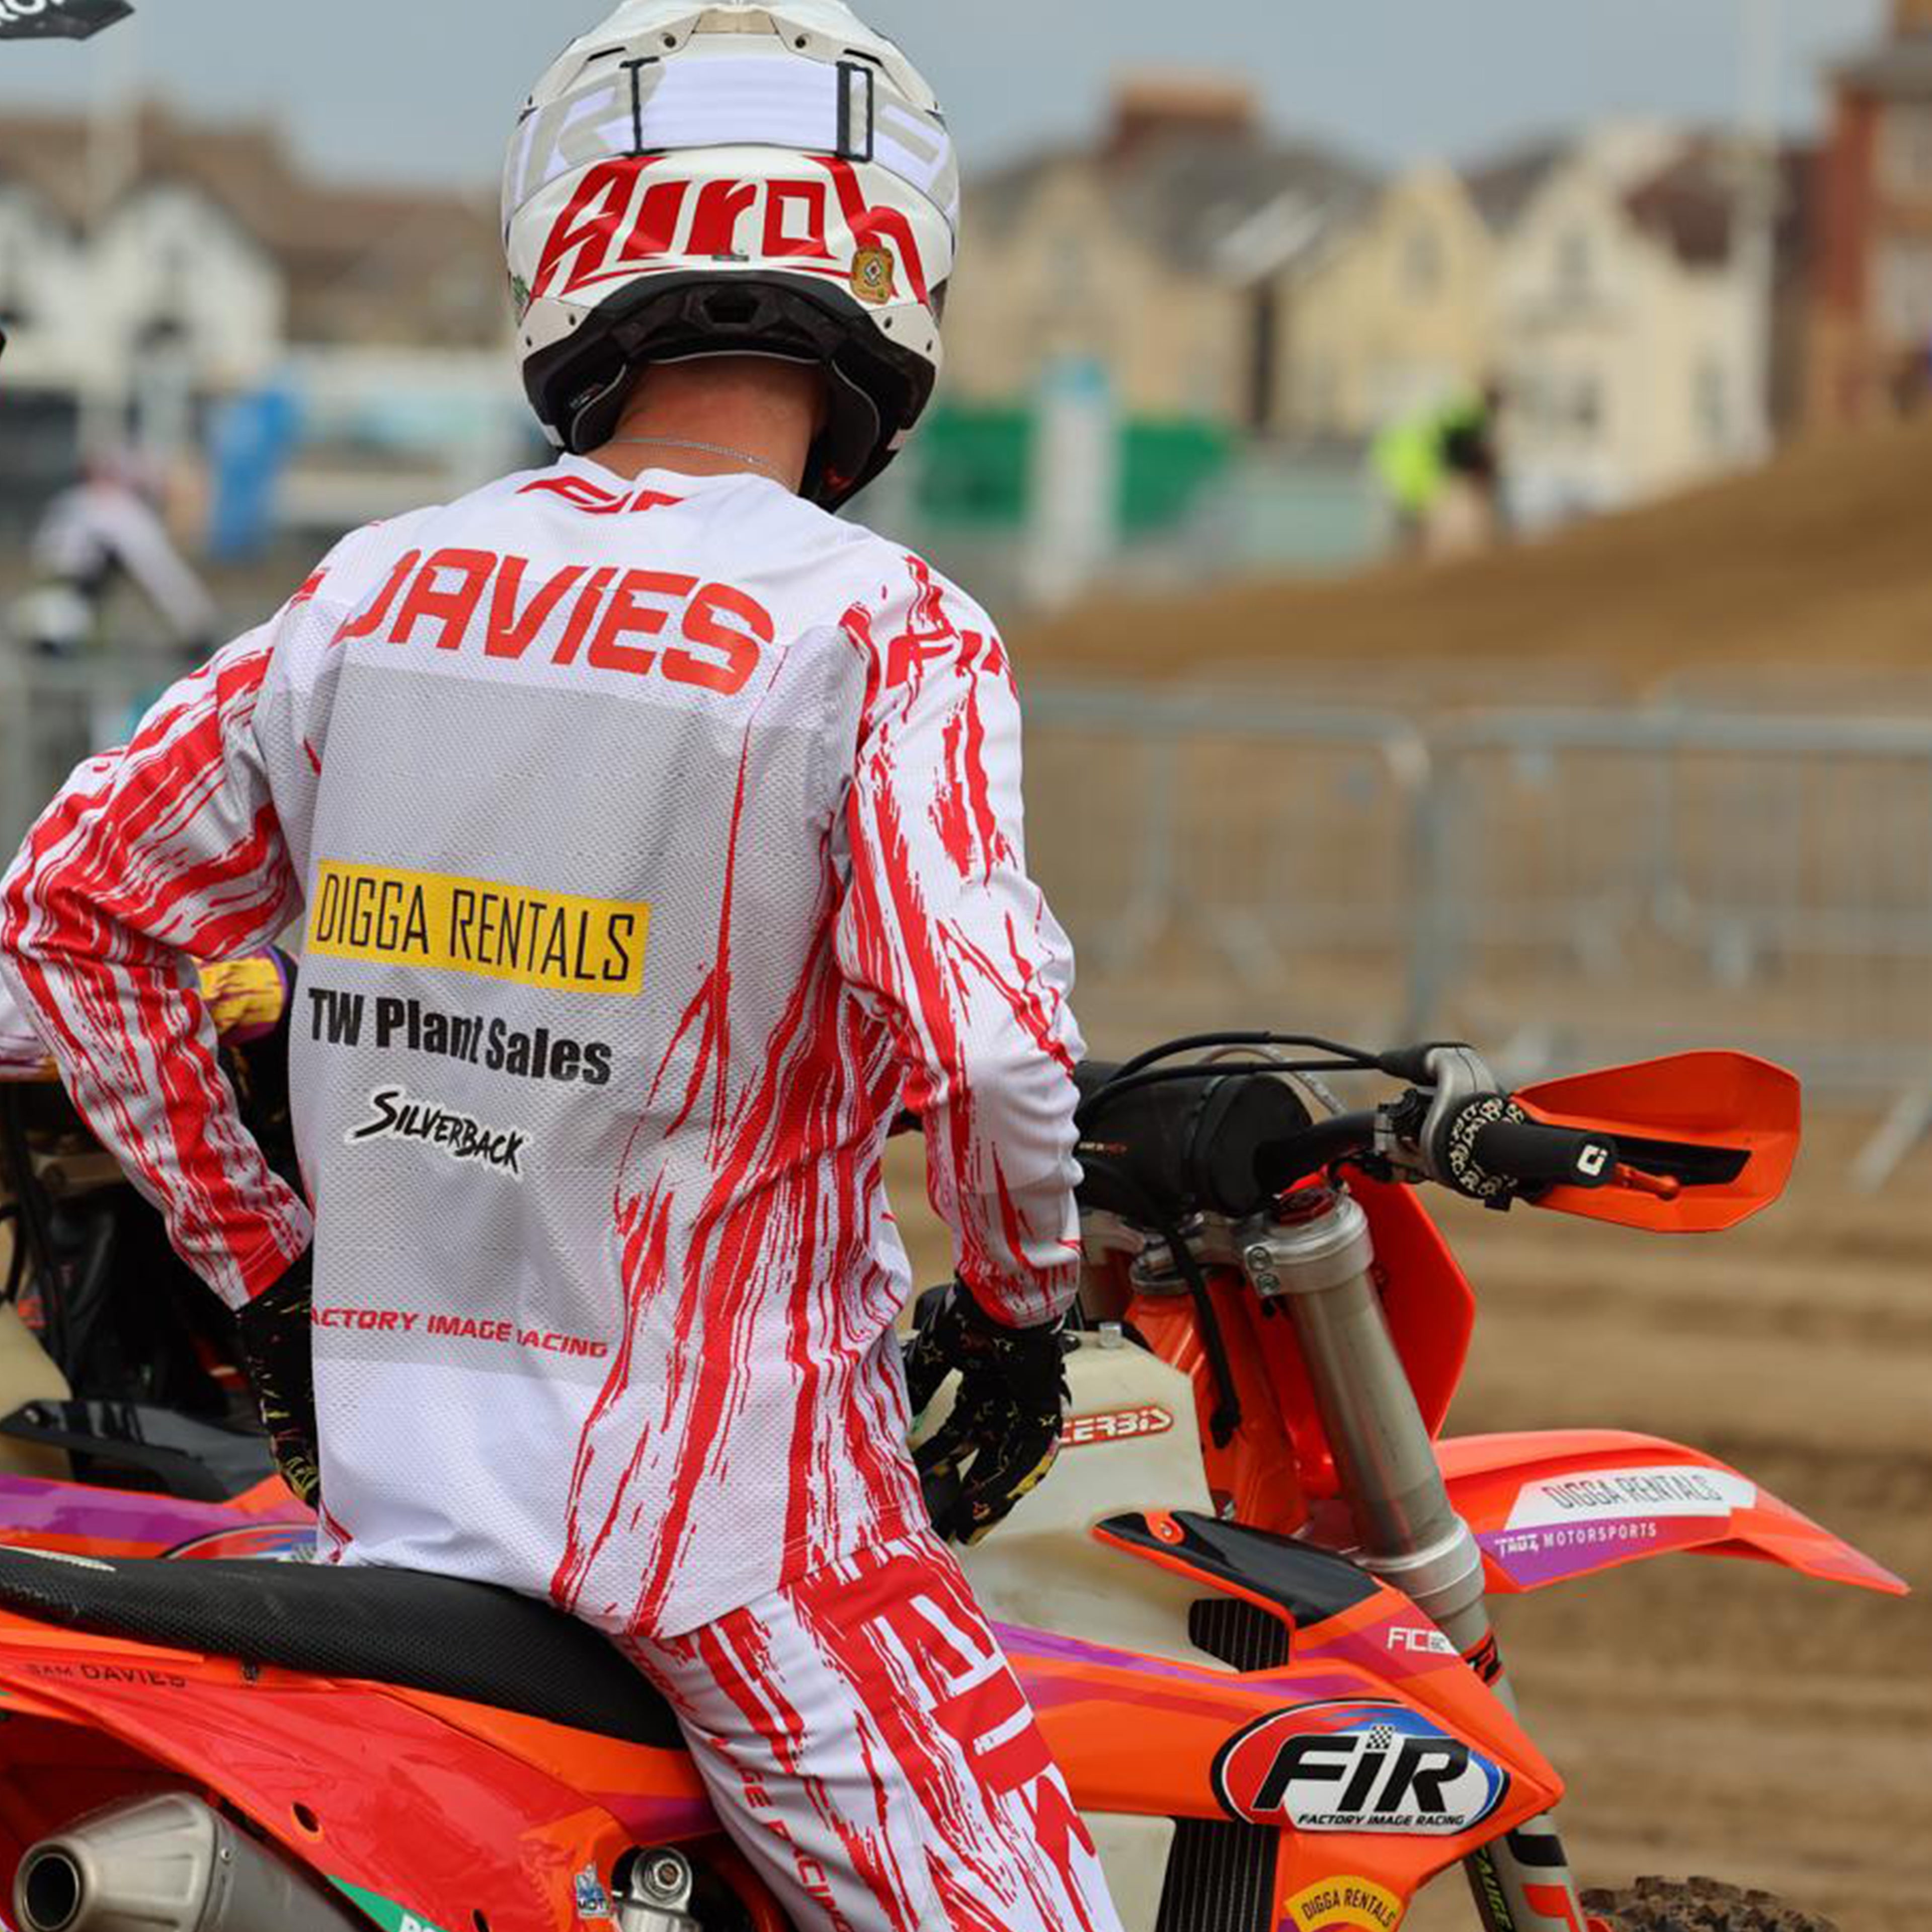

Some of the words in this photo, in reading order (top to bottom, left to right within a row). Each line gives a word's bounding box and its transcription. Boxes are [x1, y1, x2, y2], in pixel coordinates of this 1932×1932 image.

[316, 873, 429, 954] DIGGA
[450, 888, 635, 982] RENTALS
[308, 988, 364, 1046] TW
[375, 996, 484, 1065] Plant
[485, 1017, 613, 1085] Sales
[427, 1314, 513, 1342] IMAGE
[516, 1329, 608, 1358] ACING
[1541, 1479, 1628, 1509] DIGGA
[1614, 1474, 1723, 1502] RENTALS
[1543, 1522, 1657, 1547] MOTORSPORTS
[80, 1663, 186, 1688] DAVIES
[1297, 1814, 1365, 1825] FACTORY
[1366, 1814, 1414, 1825] IMAGE
[1415, 1815, 1465, 1826] RACING
[1301, 1890, 1341, 1920] DIGGA
[1344, 1888, 1397, 1928] RENTALS
